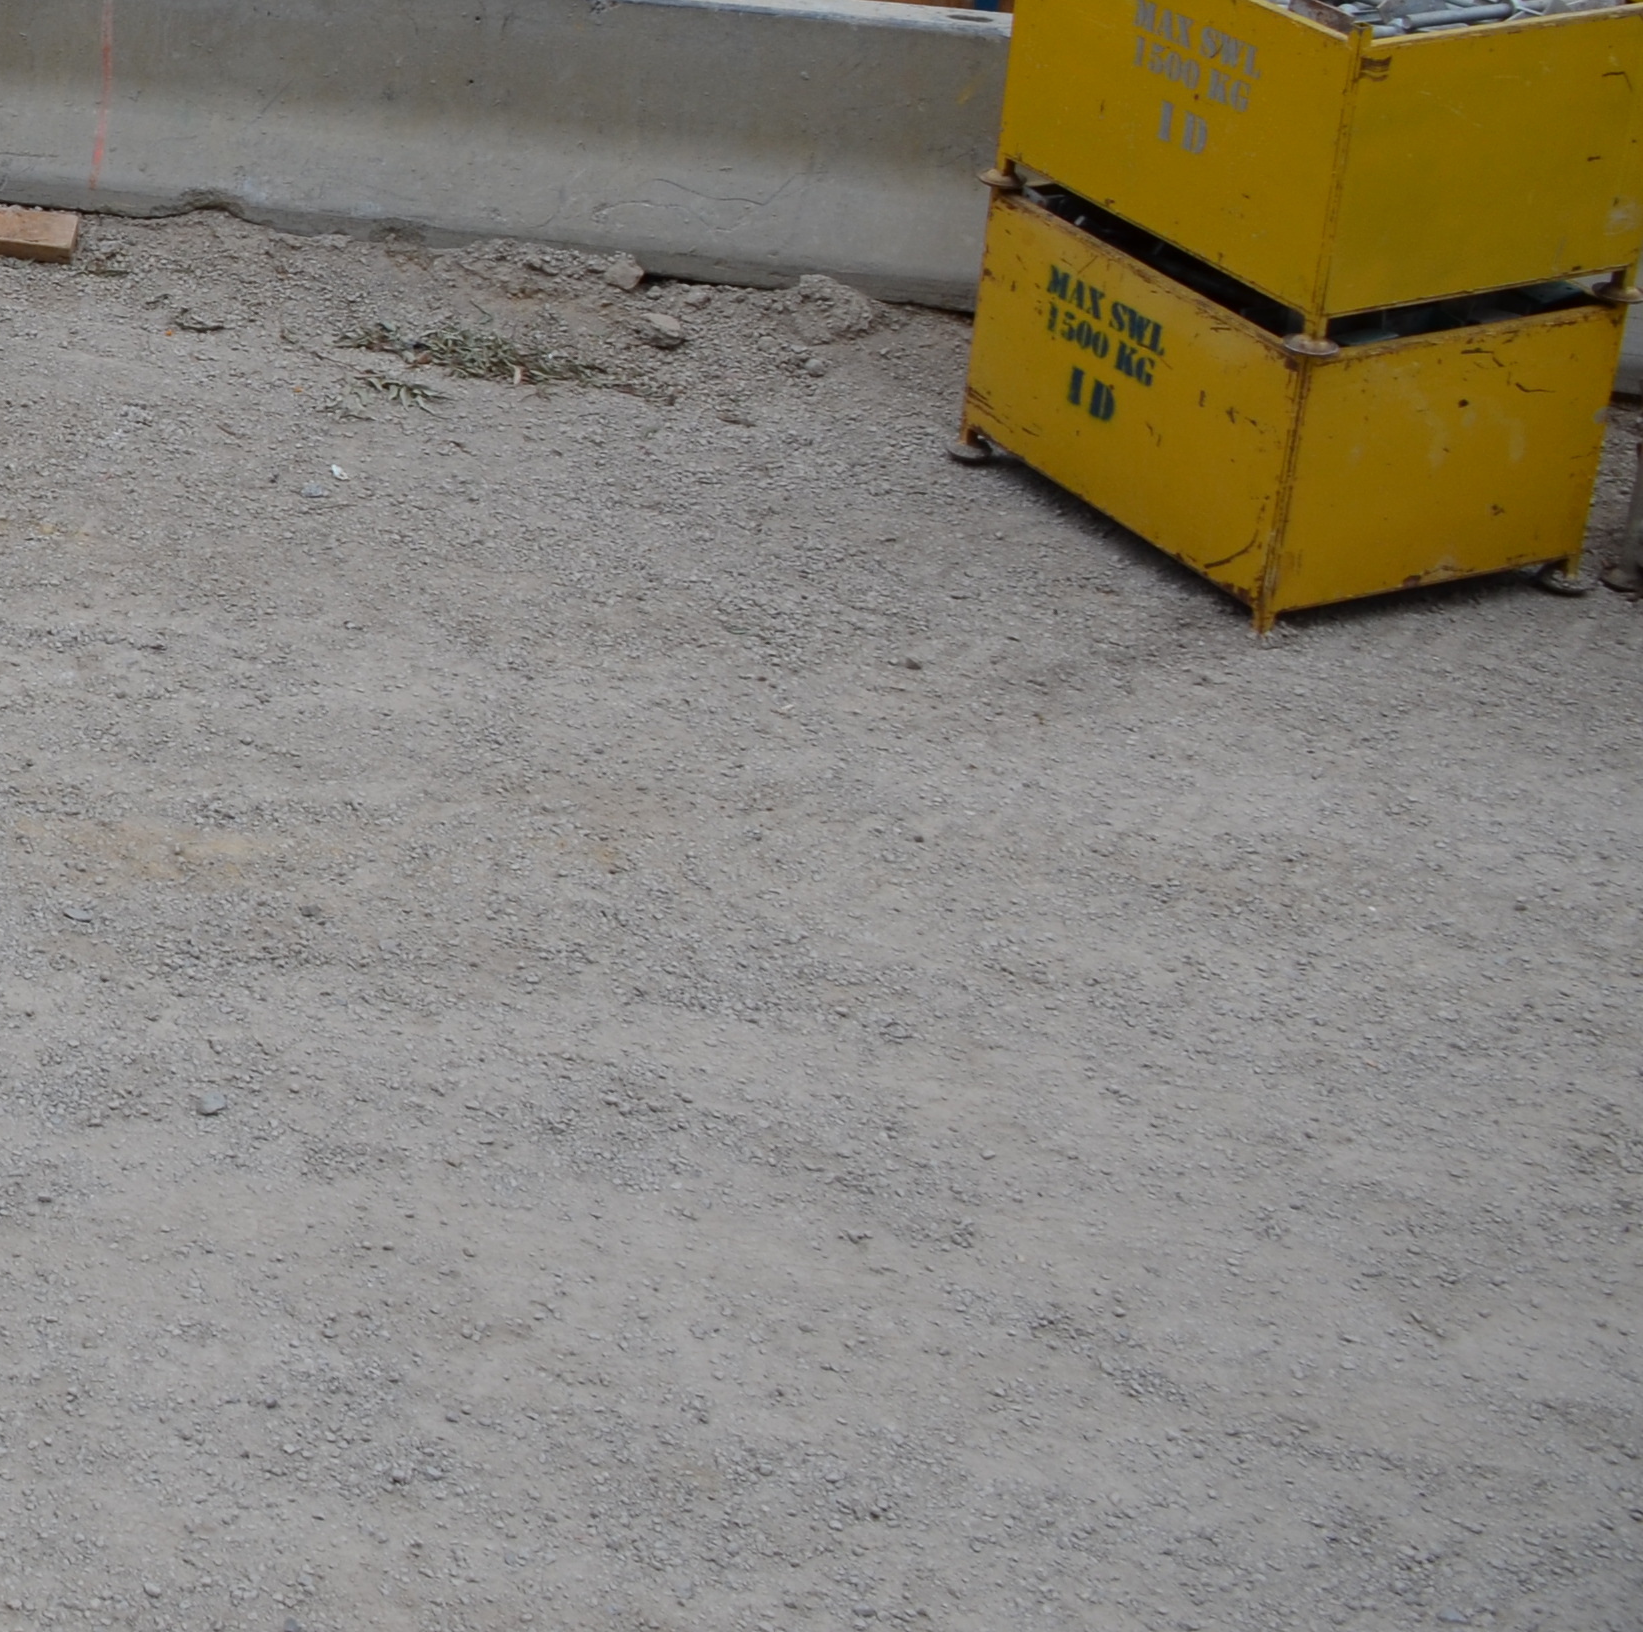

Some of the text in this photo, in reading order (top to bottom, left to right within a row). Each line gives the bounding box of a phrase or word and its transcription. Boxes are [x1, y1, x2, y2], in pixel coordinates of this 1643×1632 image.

[1133, 36, 1251, 113] 1500 KG
[1200, 25, 1262, 80] SWL
[1047, 264, 1165, 356] MAX SWL
[1048, 301, 1156, 387] 1500 KG
